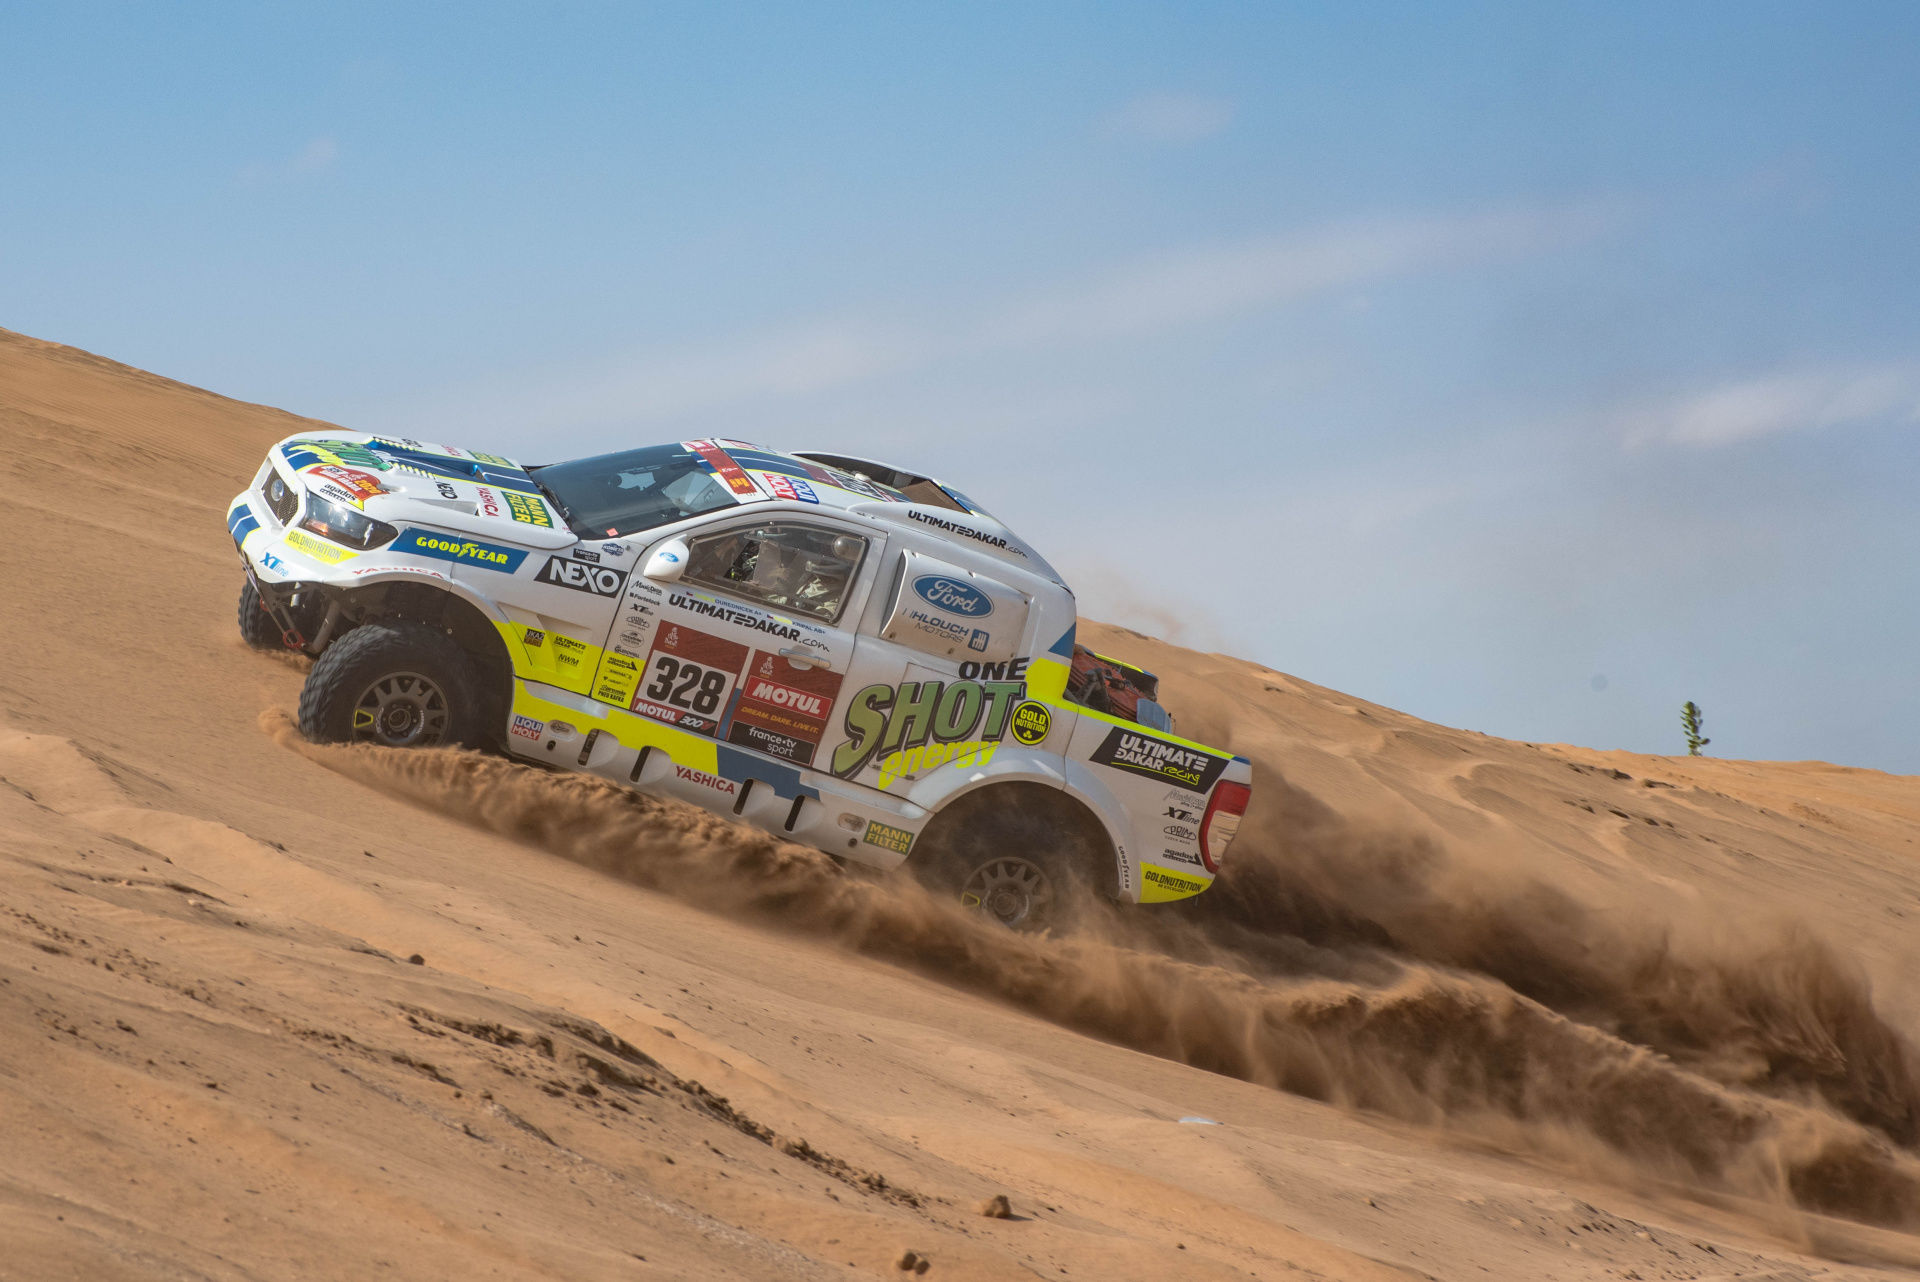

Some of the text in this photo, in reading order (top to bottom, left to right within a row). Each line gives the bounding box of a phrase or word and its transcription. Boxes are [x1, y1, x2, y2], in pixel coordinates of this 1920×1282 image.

[505, 493, 531, 523] FILTER
[522, 496, 550, 527] MANN
[288, 532, 341, 560] GOLDNUTRITION
[416, 536, 509, 565] GOODYEAR
[260, 552, 289, 578] XTline
[352, 566, 444, 579] YASHICA
[550, 558, 620, 593] NEXO
[927, 580, 979, 613] Ford
[910, 610, 970, 636] HLOUCH
[914, 623, 965, 644] MOTORS
[958, 657, 1030, 681] ONE
[646, 656, 727, 715] 328
[752, 682, 821, 715] MOTUL
[515, 716, 543, 732] LIQUI
[635, 702, 677, 721] MOTUL
[741, 706, 769, 720] DREAM.
[770, 713, 792, 726] DARE.
[792, 721, 810, 732] LIVE
[1020, 708, 1046, 725] GOLD
[512, 725, 541, 741] MOLY
[830, 680, 1028, 780] SHOT
[1015, 718, 1047, 734] NUTRITION
[767, 743, 794, 758] sport
[1114, 747, 1164, 771] DAKAR
[1120, 734, 1209, 772] ULTIMATE
[878, 741, 1000, 790] energy
[675, 766, 735, 795] YASHICA
[1162, 806, 1200, 824] XTline
[866, 833, 908, 853] FILTER
[870, 823, 913, 844] MANN
[1164, 848, 1194, 861] agados
[1144, 871, 1203, 892] GOLDNUTRITION
